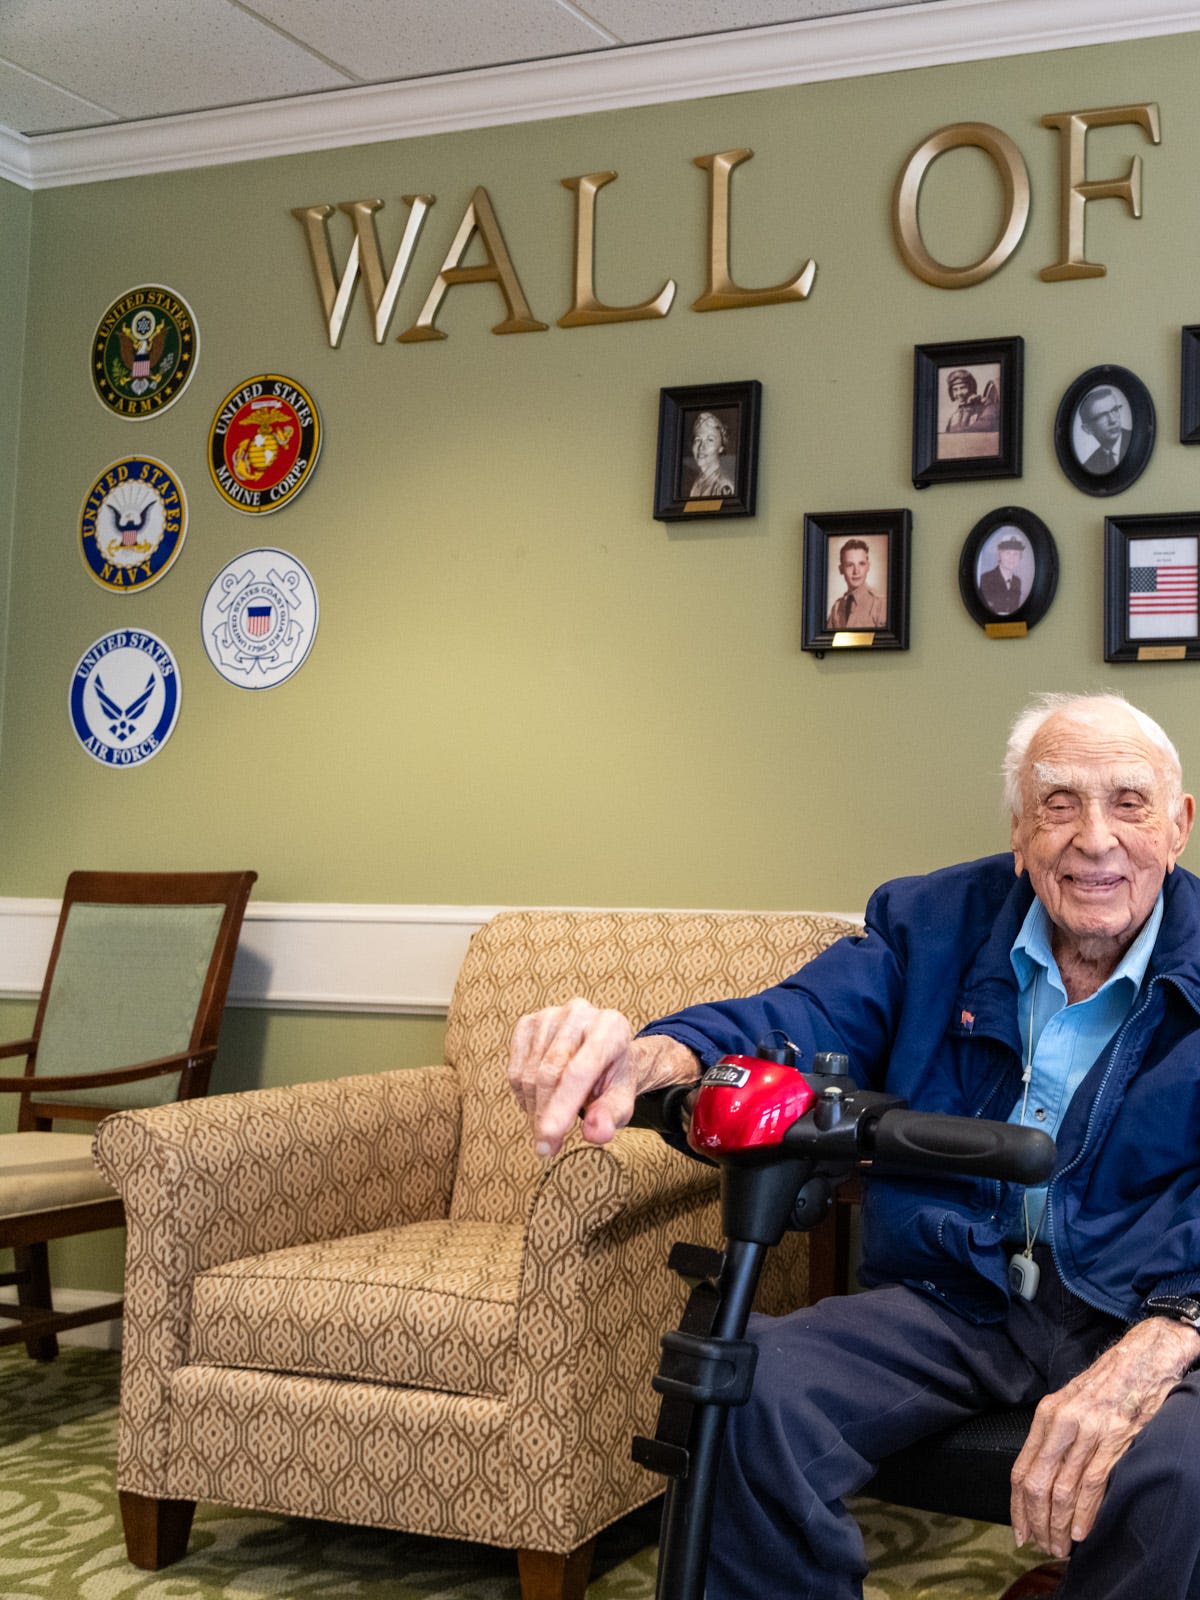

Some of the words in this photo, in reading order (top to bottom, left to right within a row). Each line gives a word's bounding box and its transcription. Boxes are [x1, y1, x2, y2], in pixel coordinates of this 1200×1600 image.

[292, 147, 818, 350] WALL
[892, 102, 1161, 290] OF
[100, 293, 145, 338] UNITED
[147, 292, 190, 331] STATES
[114, 393, 163, 413] ARMY
[216, 383, 263, 435] UNITED
[272, 382, 313, 428] STATES
[83, 465, 129, 537] UNITED
[140, 464, 180, 532] STATES
[216, 465, 261, 506] MARINE
[269, 458, 308, 501] CORPS
[100, 561, 153, 585] NAVY
[233, 586, 260, 613] STATES
[261, 586, 285, 609] COAST
[231, 614, 248, 649] UNITED
[269, 610, 287, 647] GUARD
[77, 633, 127, 679] UNITED
[129, 633, 173, 677] STATES
[84, 735, 109, 760] AIR
[112, 734, 160, 764] FORCE
